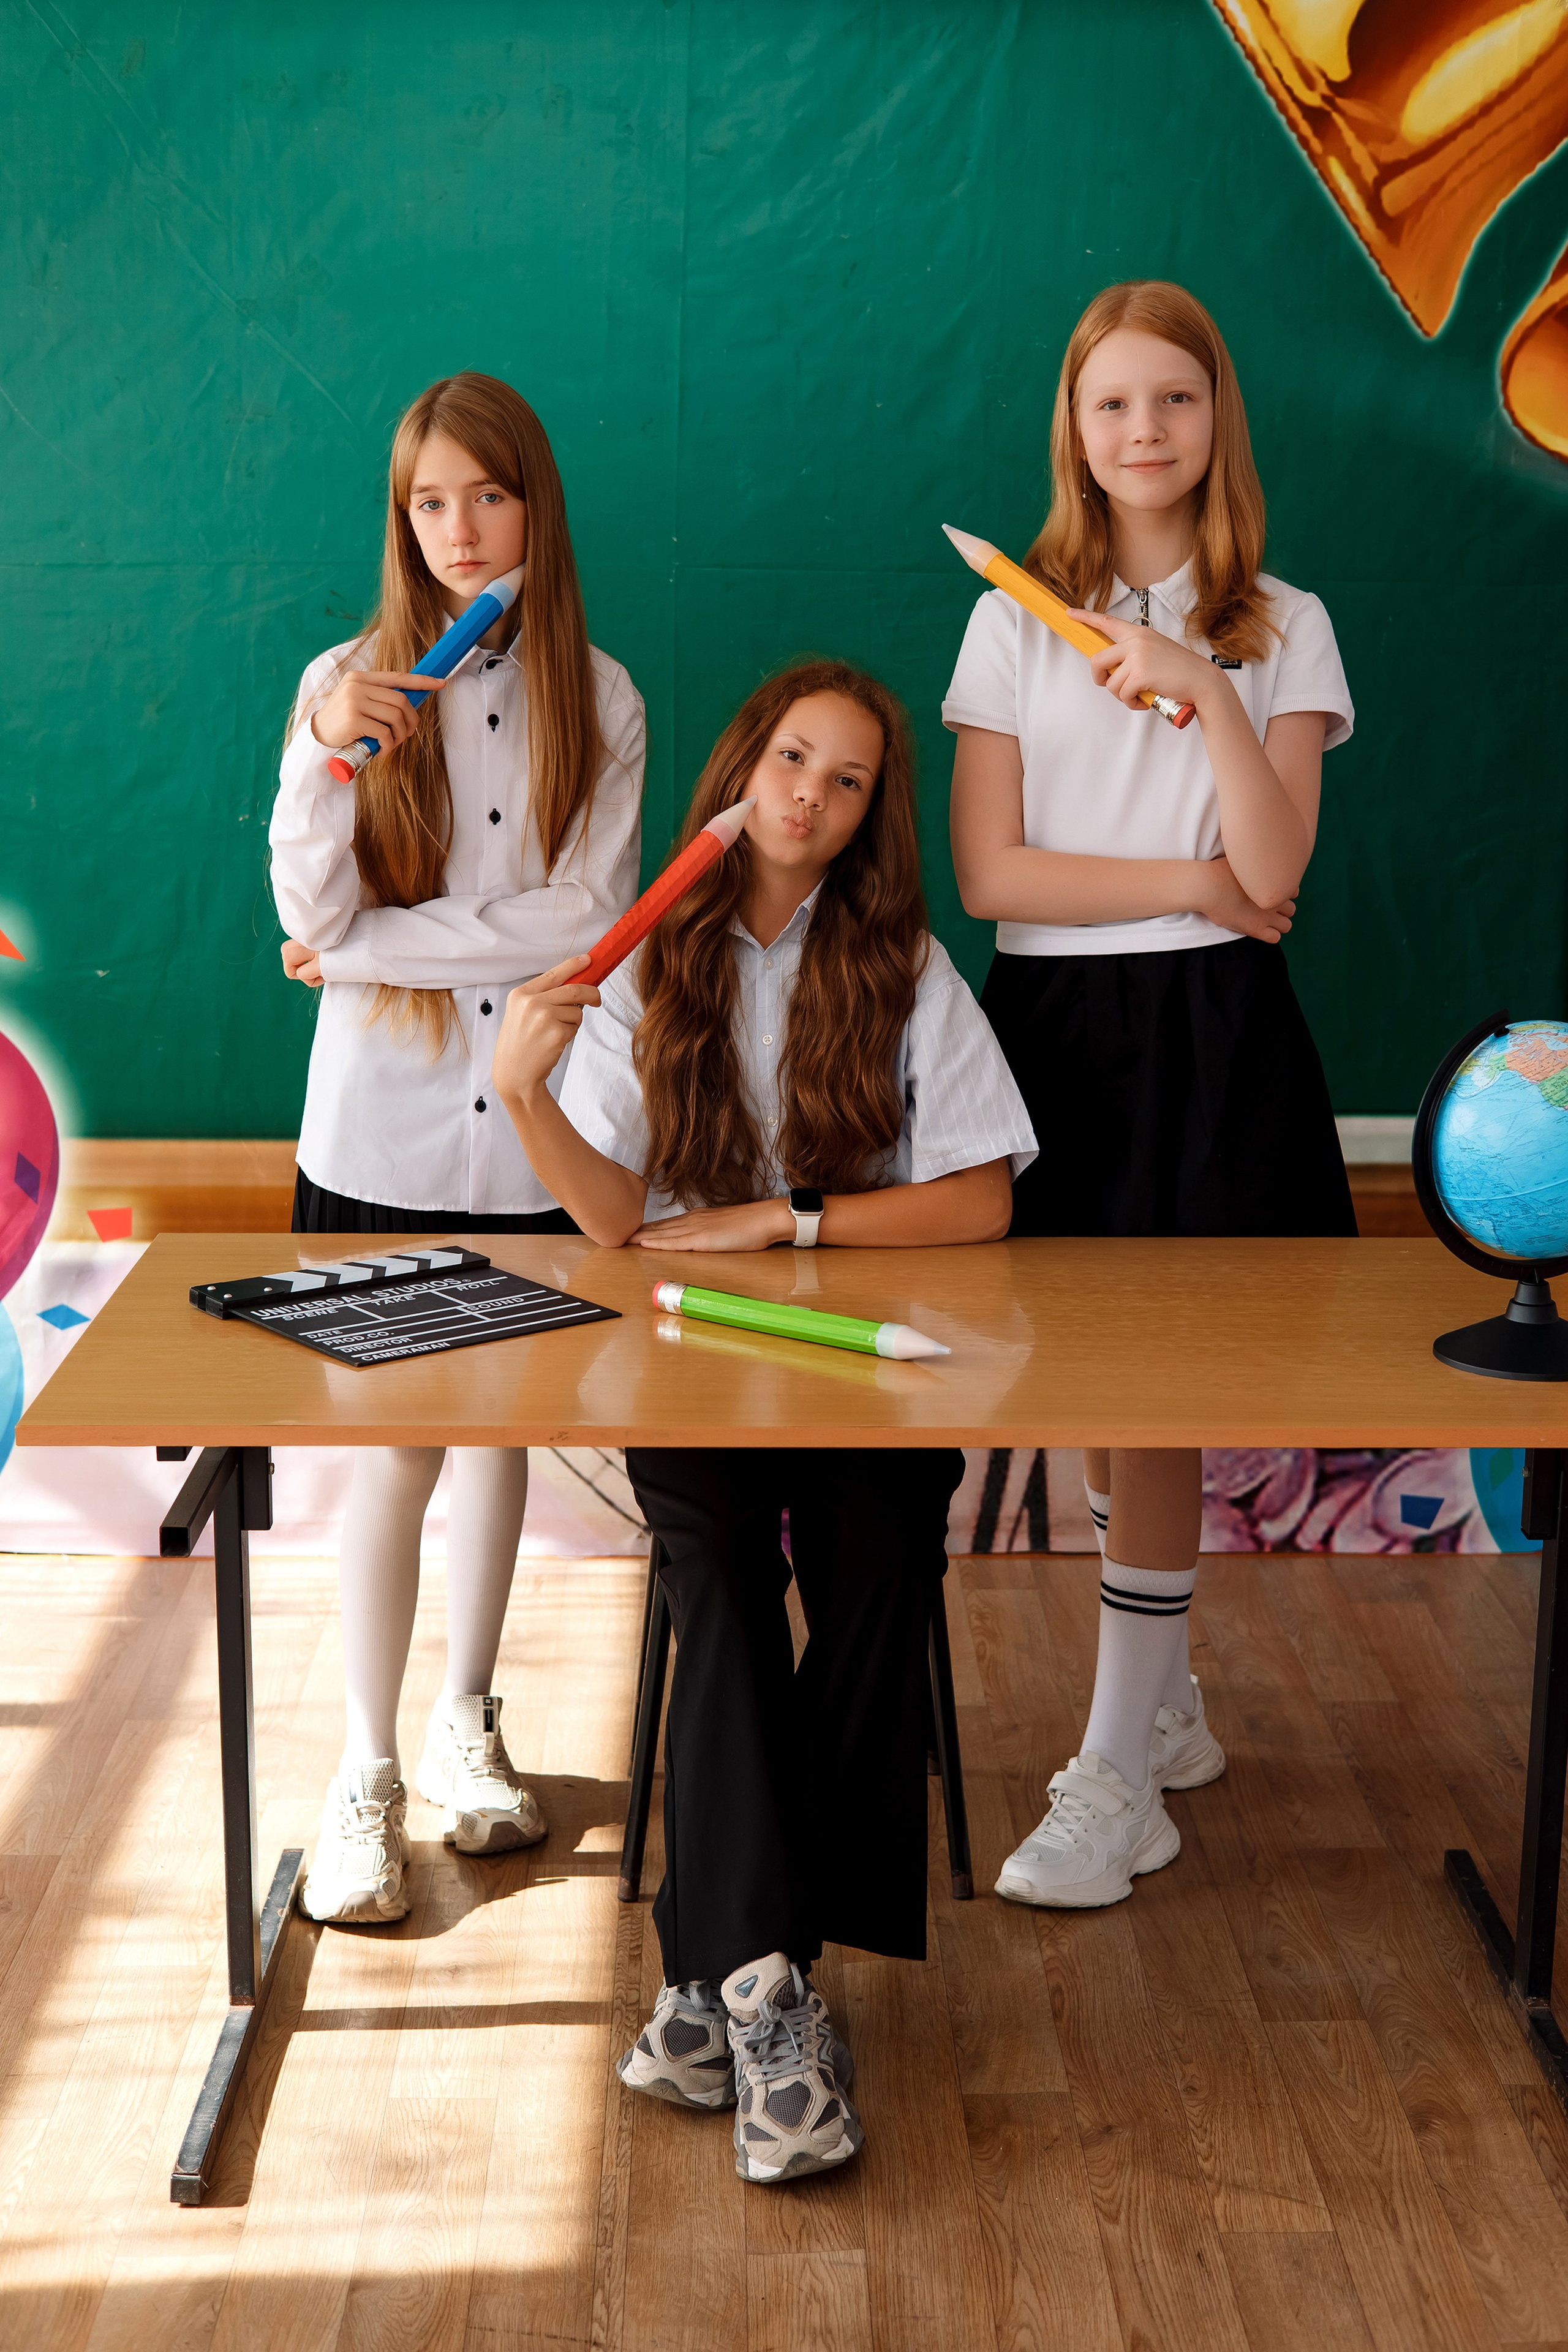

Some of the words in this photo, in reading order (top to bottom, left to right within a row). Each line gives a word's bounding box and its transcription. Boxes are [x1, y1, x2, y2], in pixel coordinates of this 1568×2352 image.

[456, 1281, 500, 1291] ROLL
[251, 1294, 371, 1317] UNIVERSAL
[371, 1295, 416, 1306] TAKE
[467, 1296, 524, 1311] SOUND
[282, 1308, 339, 1321] SCENE
[307, 1330, 343, 1339] DATE
[340, 1337, 413, 1353] DIRECTOR
[361, 1342, 450, 1361] CAMERAMAN
